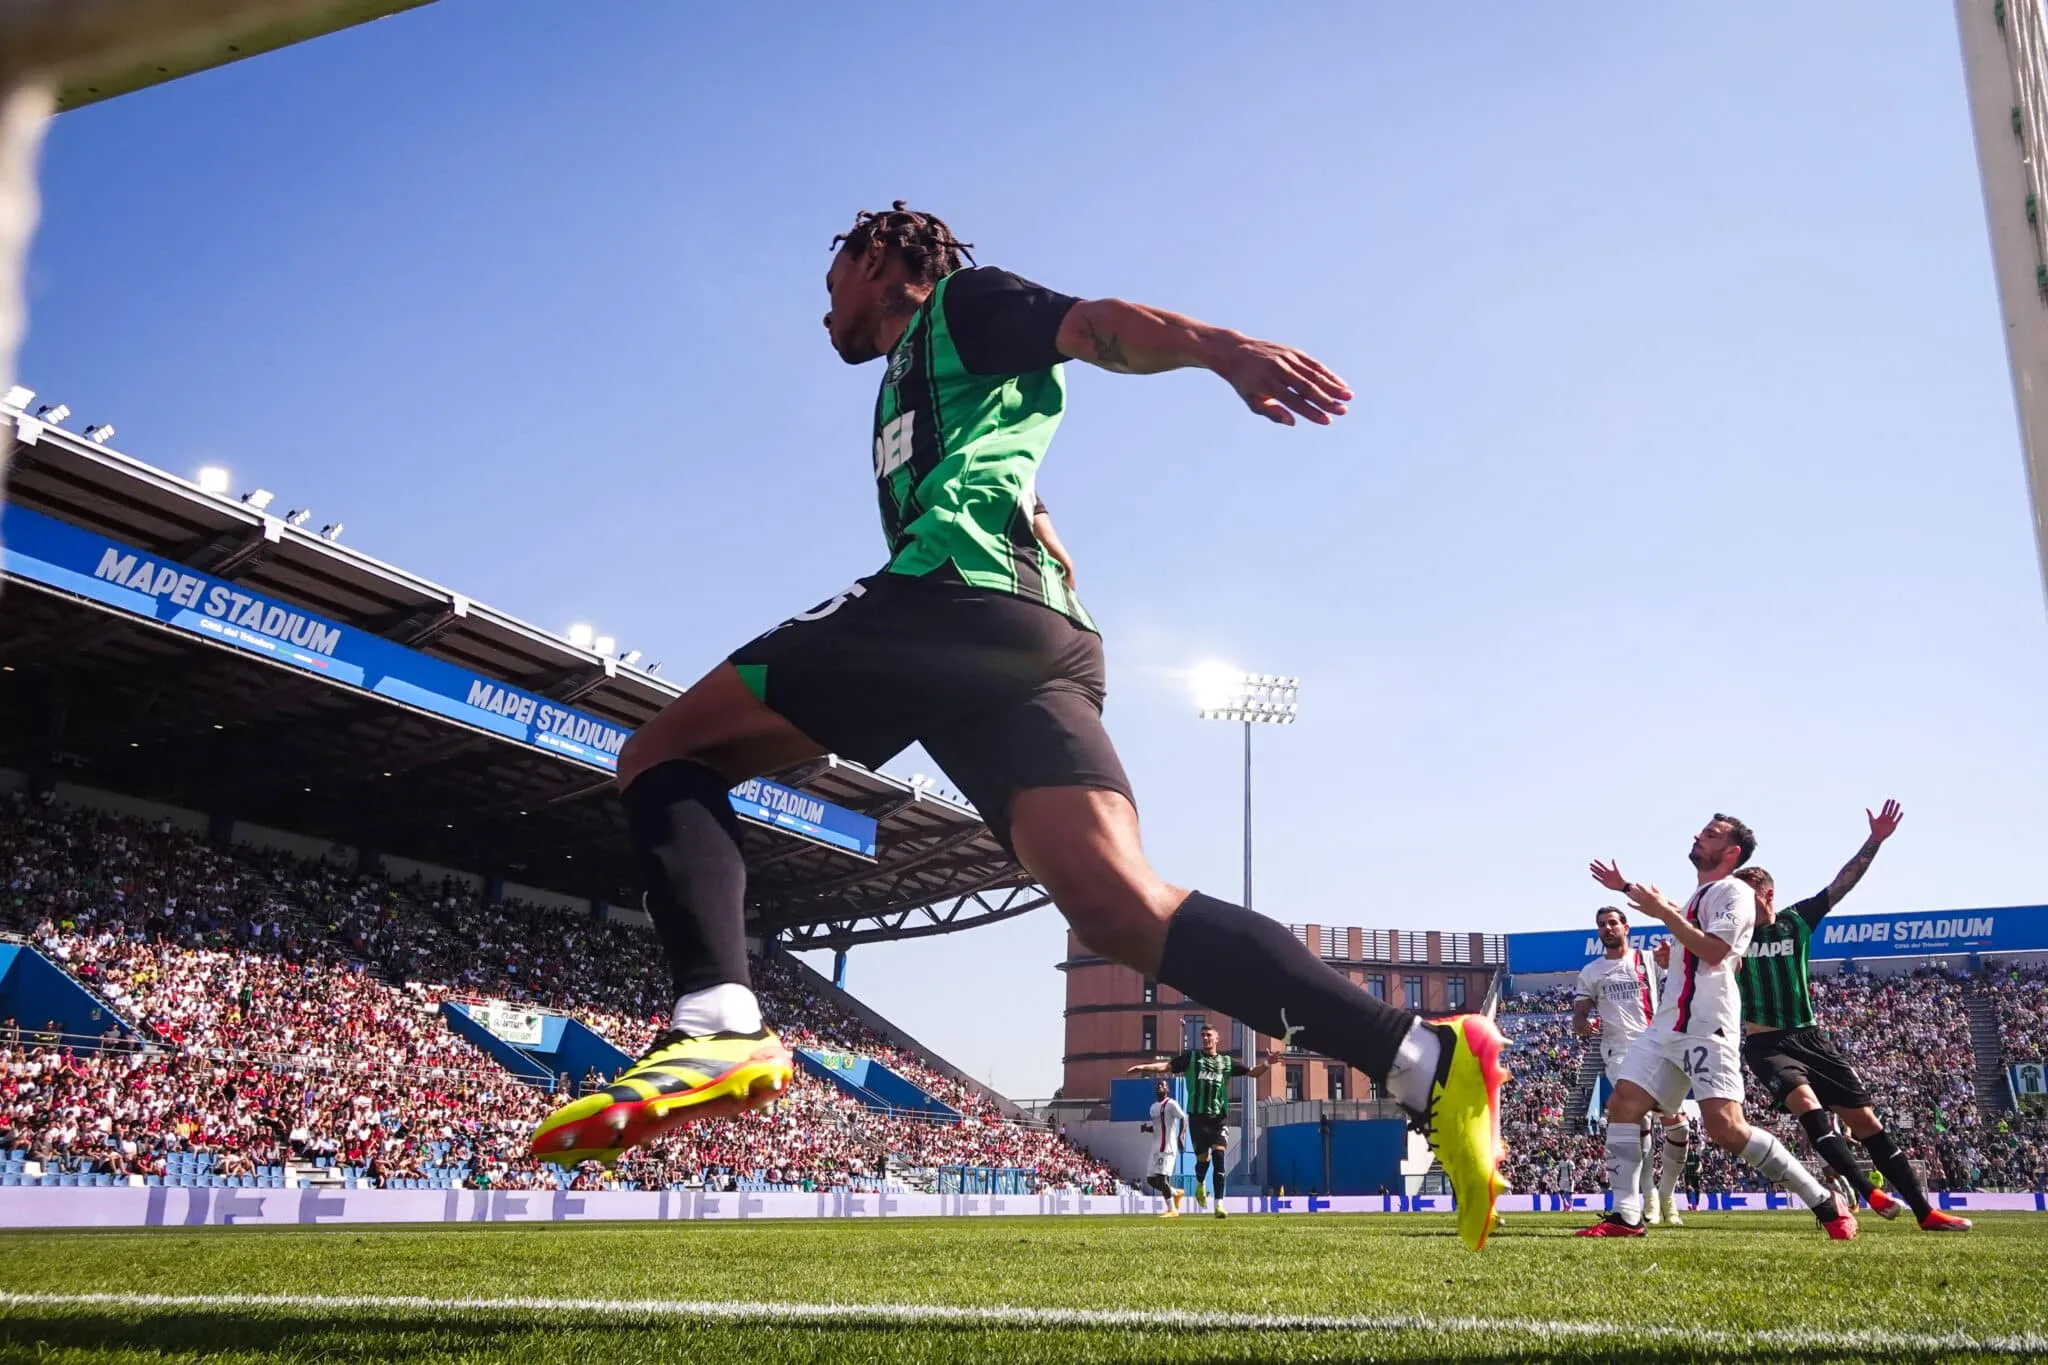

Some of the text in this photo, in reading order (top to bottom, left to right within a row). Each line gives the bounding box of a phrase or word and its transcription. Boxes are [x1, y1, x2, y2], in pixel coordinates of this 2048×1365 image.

[94, 547, 341, 656] MAPEI STADIUM
[466, 680, 537, 724] MAPEI
[536, 705, 626, 756] STADIUM
[760, 785, 825, 824] STADIUM
[1585, 935, 1646, 956] MEI
[1824, 917, 1993, 944] MAPEI STADIUM
[1744, 939, 1794, 958] MAPEI
[1683, 1046, 1709, 1076] 42
